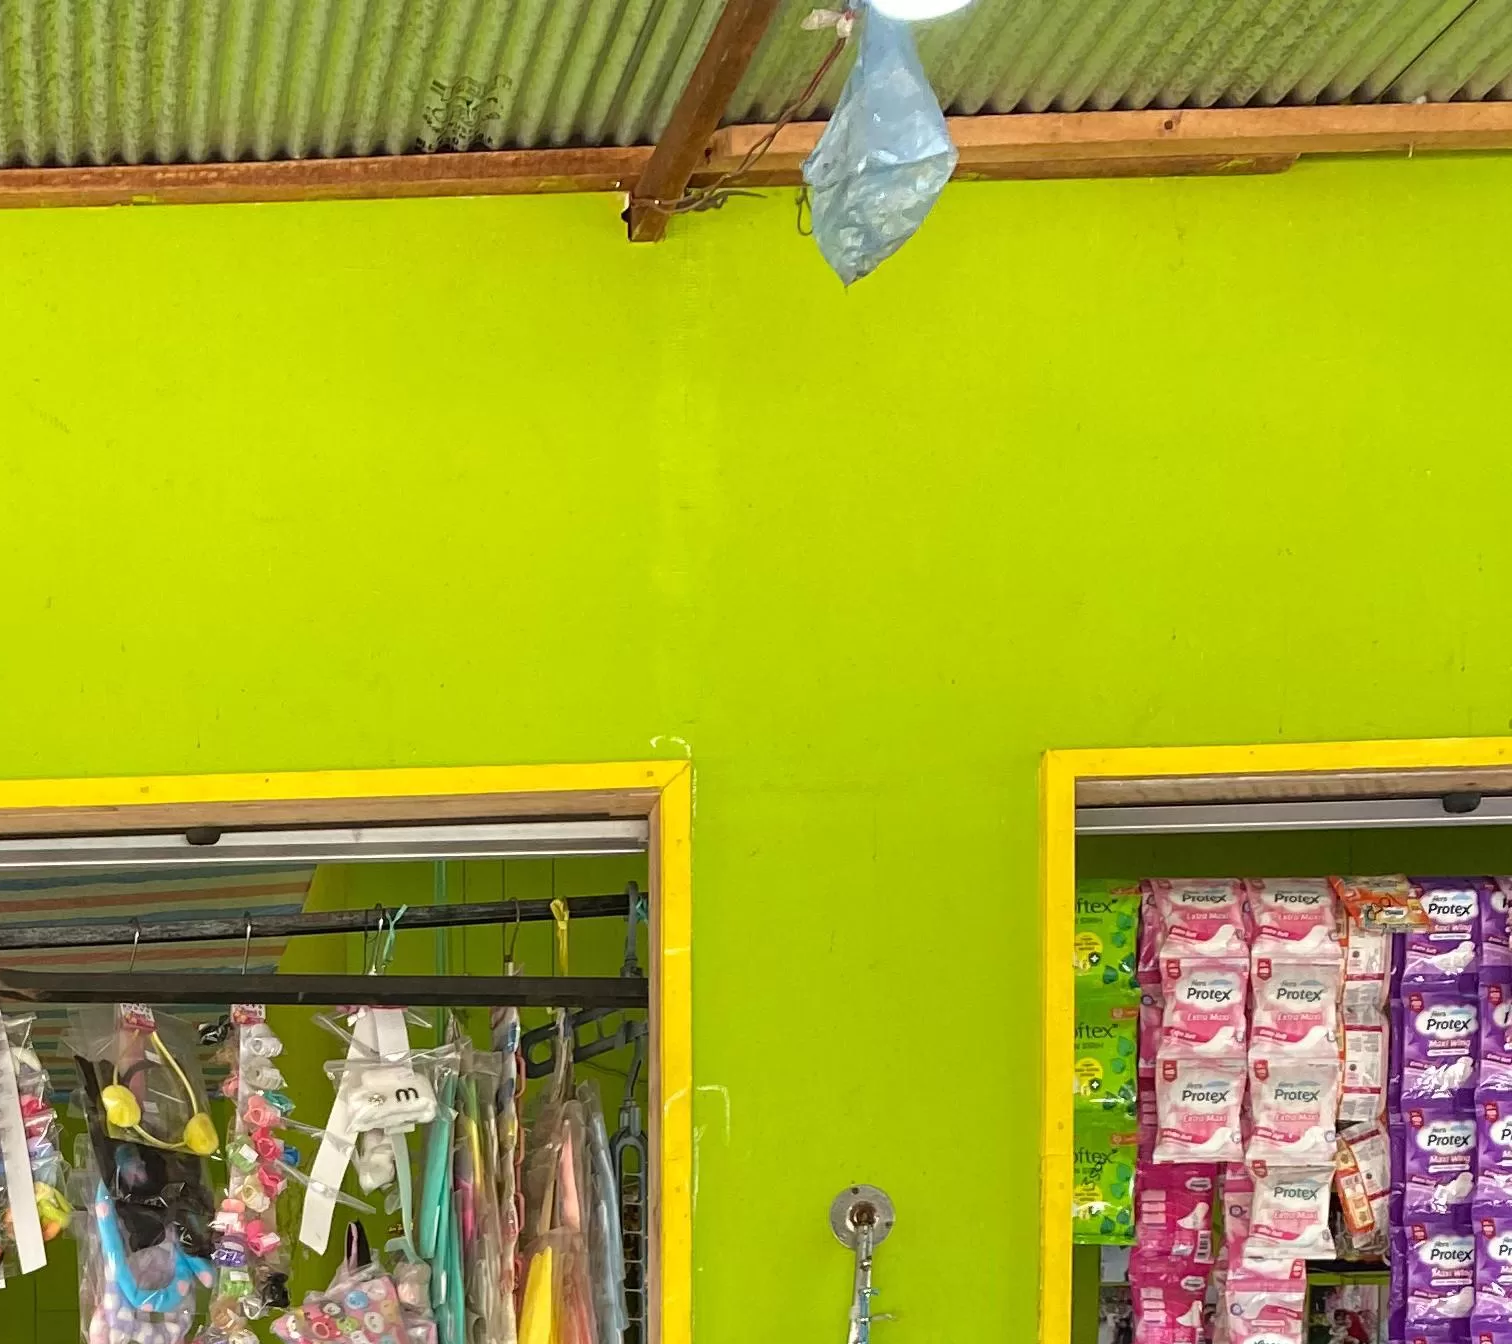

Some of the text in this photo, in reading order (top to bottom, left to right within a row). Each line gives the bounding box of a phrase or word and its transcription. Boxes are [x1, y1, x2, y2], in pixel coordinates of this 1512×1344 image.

[1274, 892, 1321, 905] Protex
[1075, 899, 1114, 914] ftex
[1428, 903, 1473, 917] Protex
[1187, 987, 1232, 1002] Protex
[1276, 987, 1324, 1002] Protex
[1426, 1018, 1471, 1032] Protex
[1182, 1090, 1230, 1104] Protex
[1274, 1088, 1321, 1102] Protex
[1428, 1134, 1471, 1147] Protex
[1274, 1186, 1321, 1200] Protex
[1430, 1248, 1474, 1262] Protex
